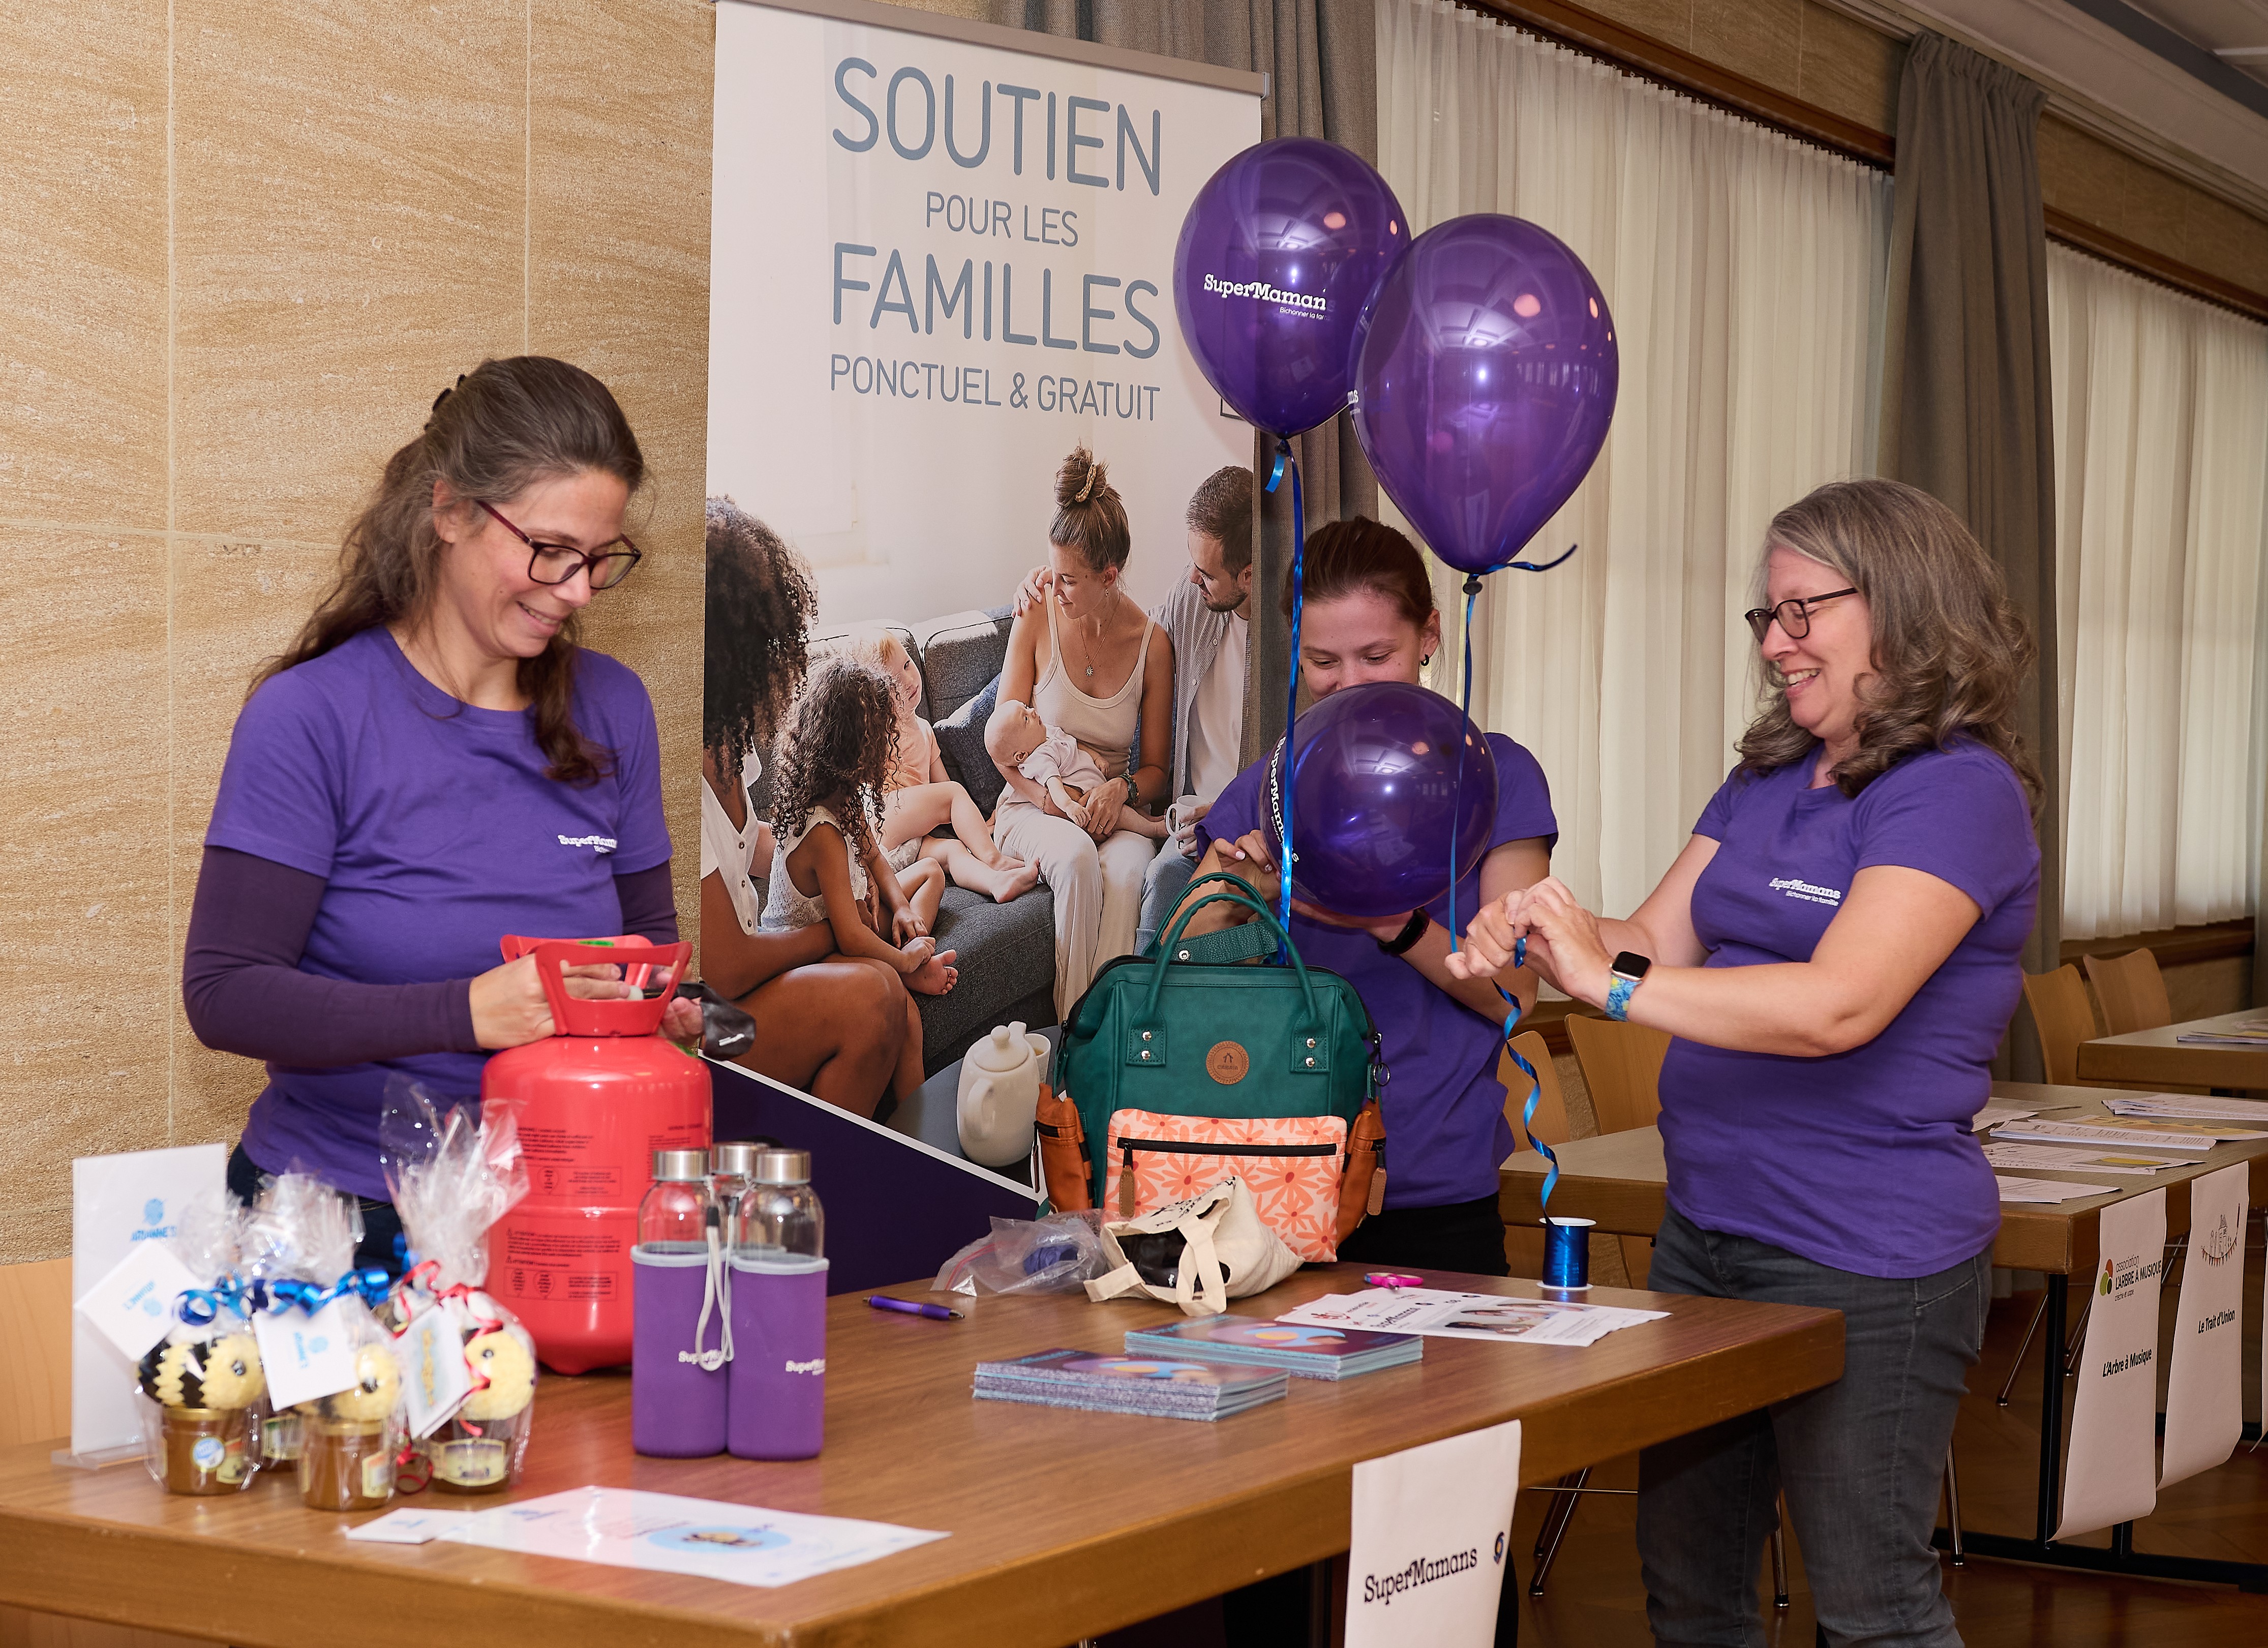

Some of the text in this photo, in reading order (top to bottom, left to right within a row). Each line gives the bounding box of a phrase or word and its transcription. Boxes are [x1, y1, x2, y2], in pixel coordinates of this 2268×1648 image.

[832, 57, 1161, 196] SOUTIEN
[926, 191, 1078, 247] POUR LES
[833, 242, 1160, 359] FAMILLES
[1280, 306, 1309, 317] Bichonner
[831, 354, 1161, 422] PONCTUEL & GRATUIT
[1768, 877, 1841, 900] SuperMamans
[2115, 1254, 2139, 1273] association
[2115, 1260, 2162, 1291] L'ARBRE À MUSIQUE
[2198, 1308, 2235, 1334] Le Trait d'Union
[2102, 1349, 2152, 1377] L'Arbre à Musique
[1364, 1548, 1477, 1605] SuperMamans
